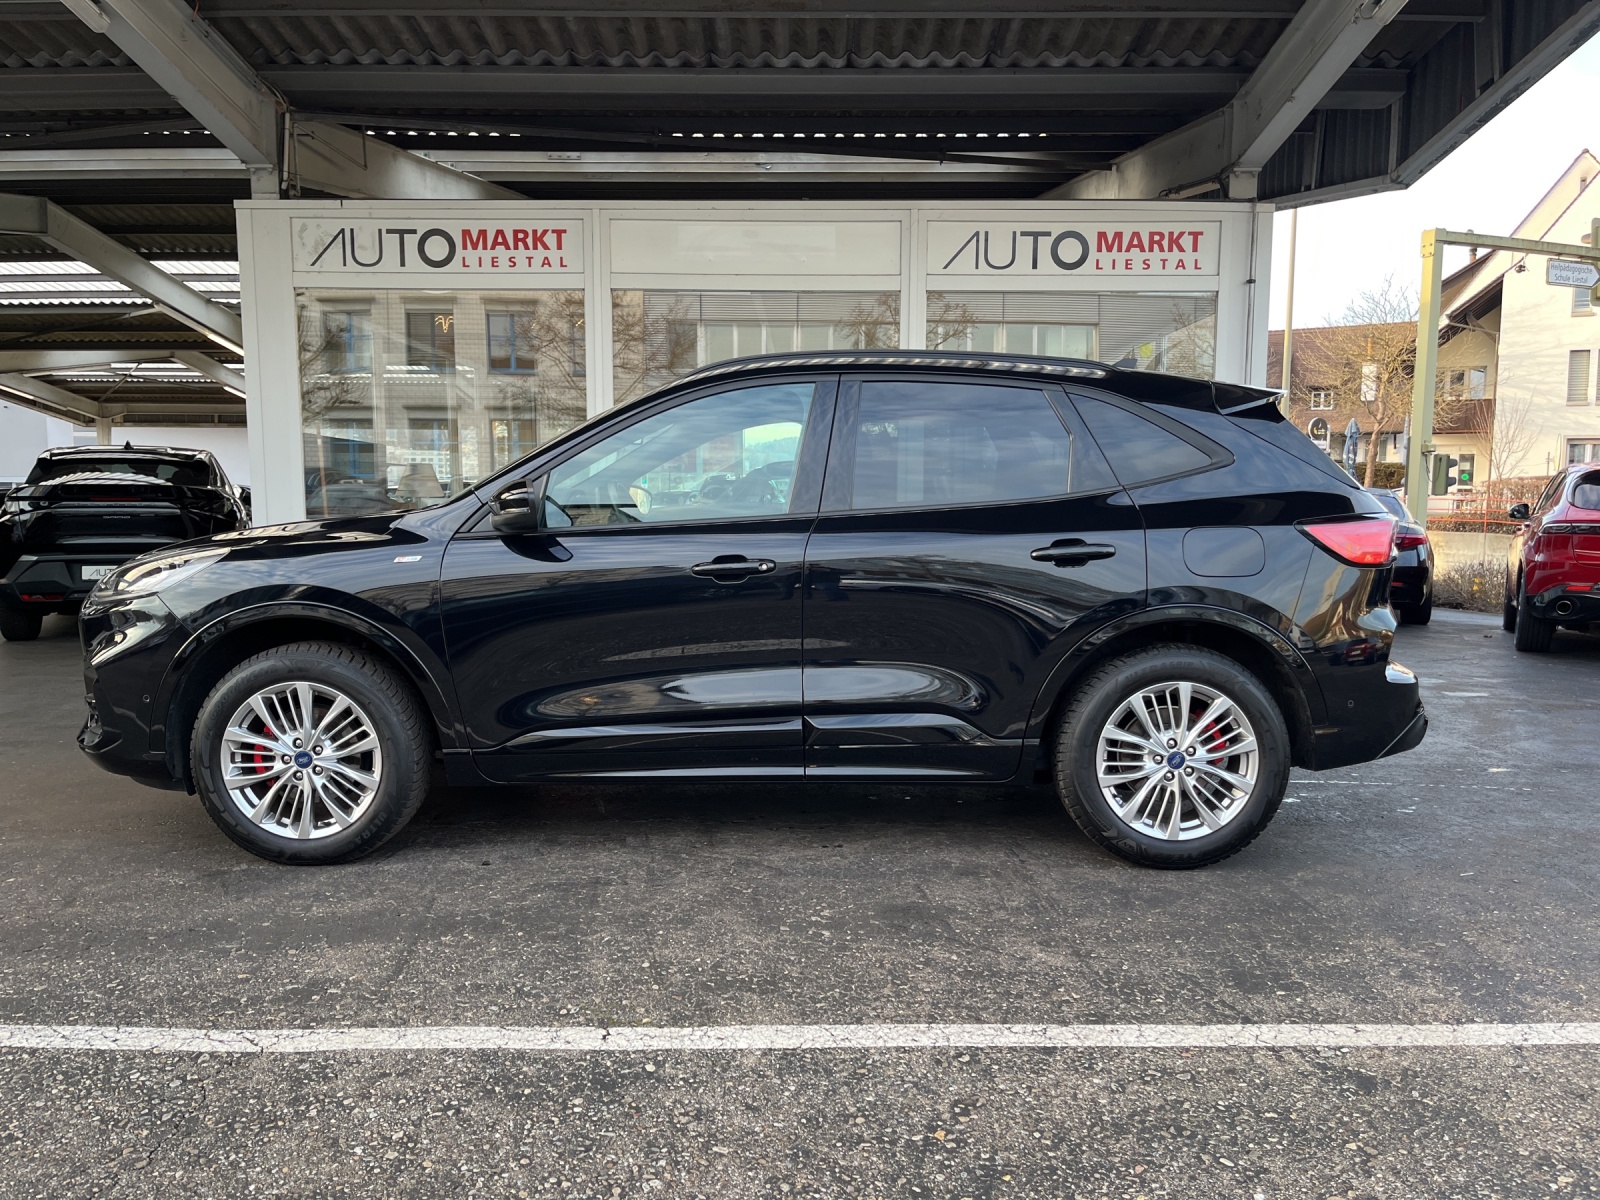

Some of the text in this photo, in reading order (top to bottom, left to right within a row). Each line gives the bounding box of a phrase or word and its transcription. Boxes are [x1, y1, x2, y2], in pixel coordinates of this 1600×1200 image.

[309, 227, 568, 269] AUTO MARKT
[942, 230, 1204, 271] AUTO MARKT
[461, 256, 568, 268] LIESTAL
[1095, 258, 1202, 270] LIESTAL
